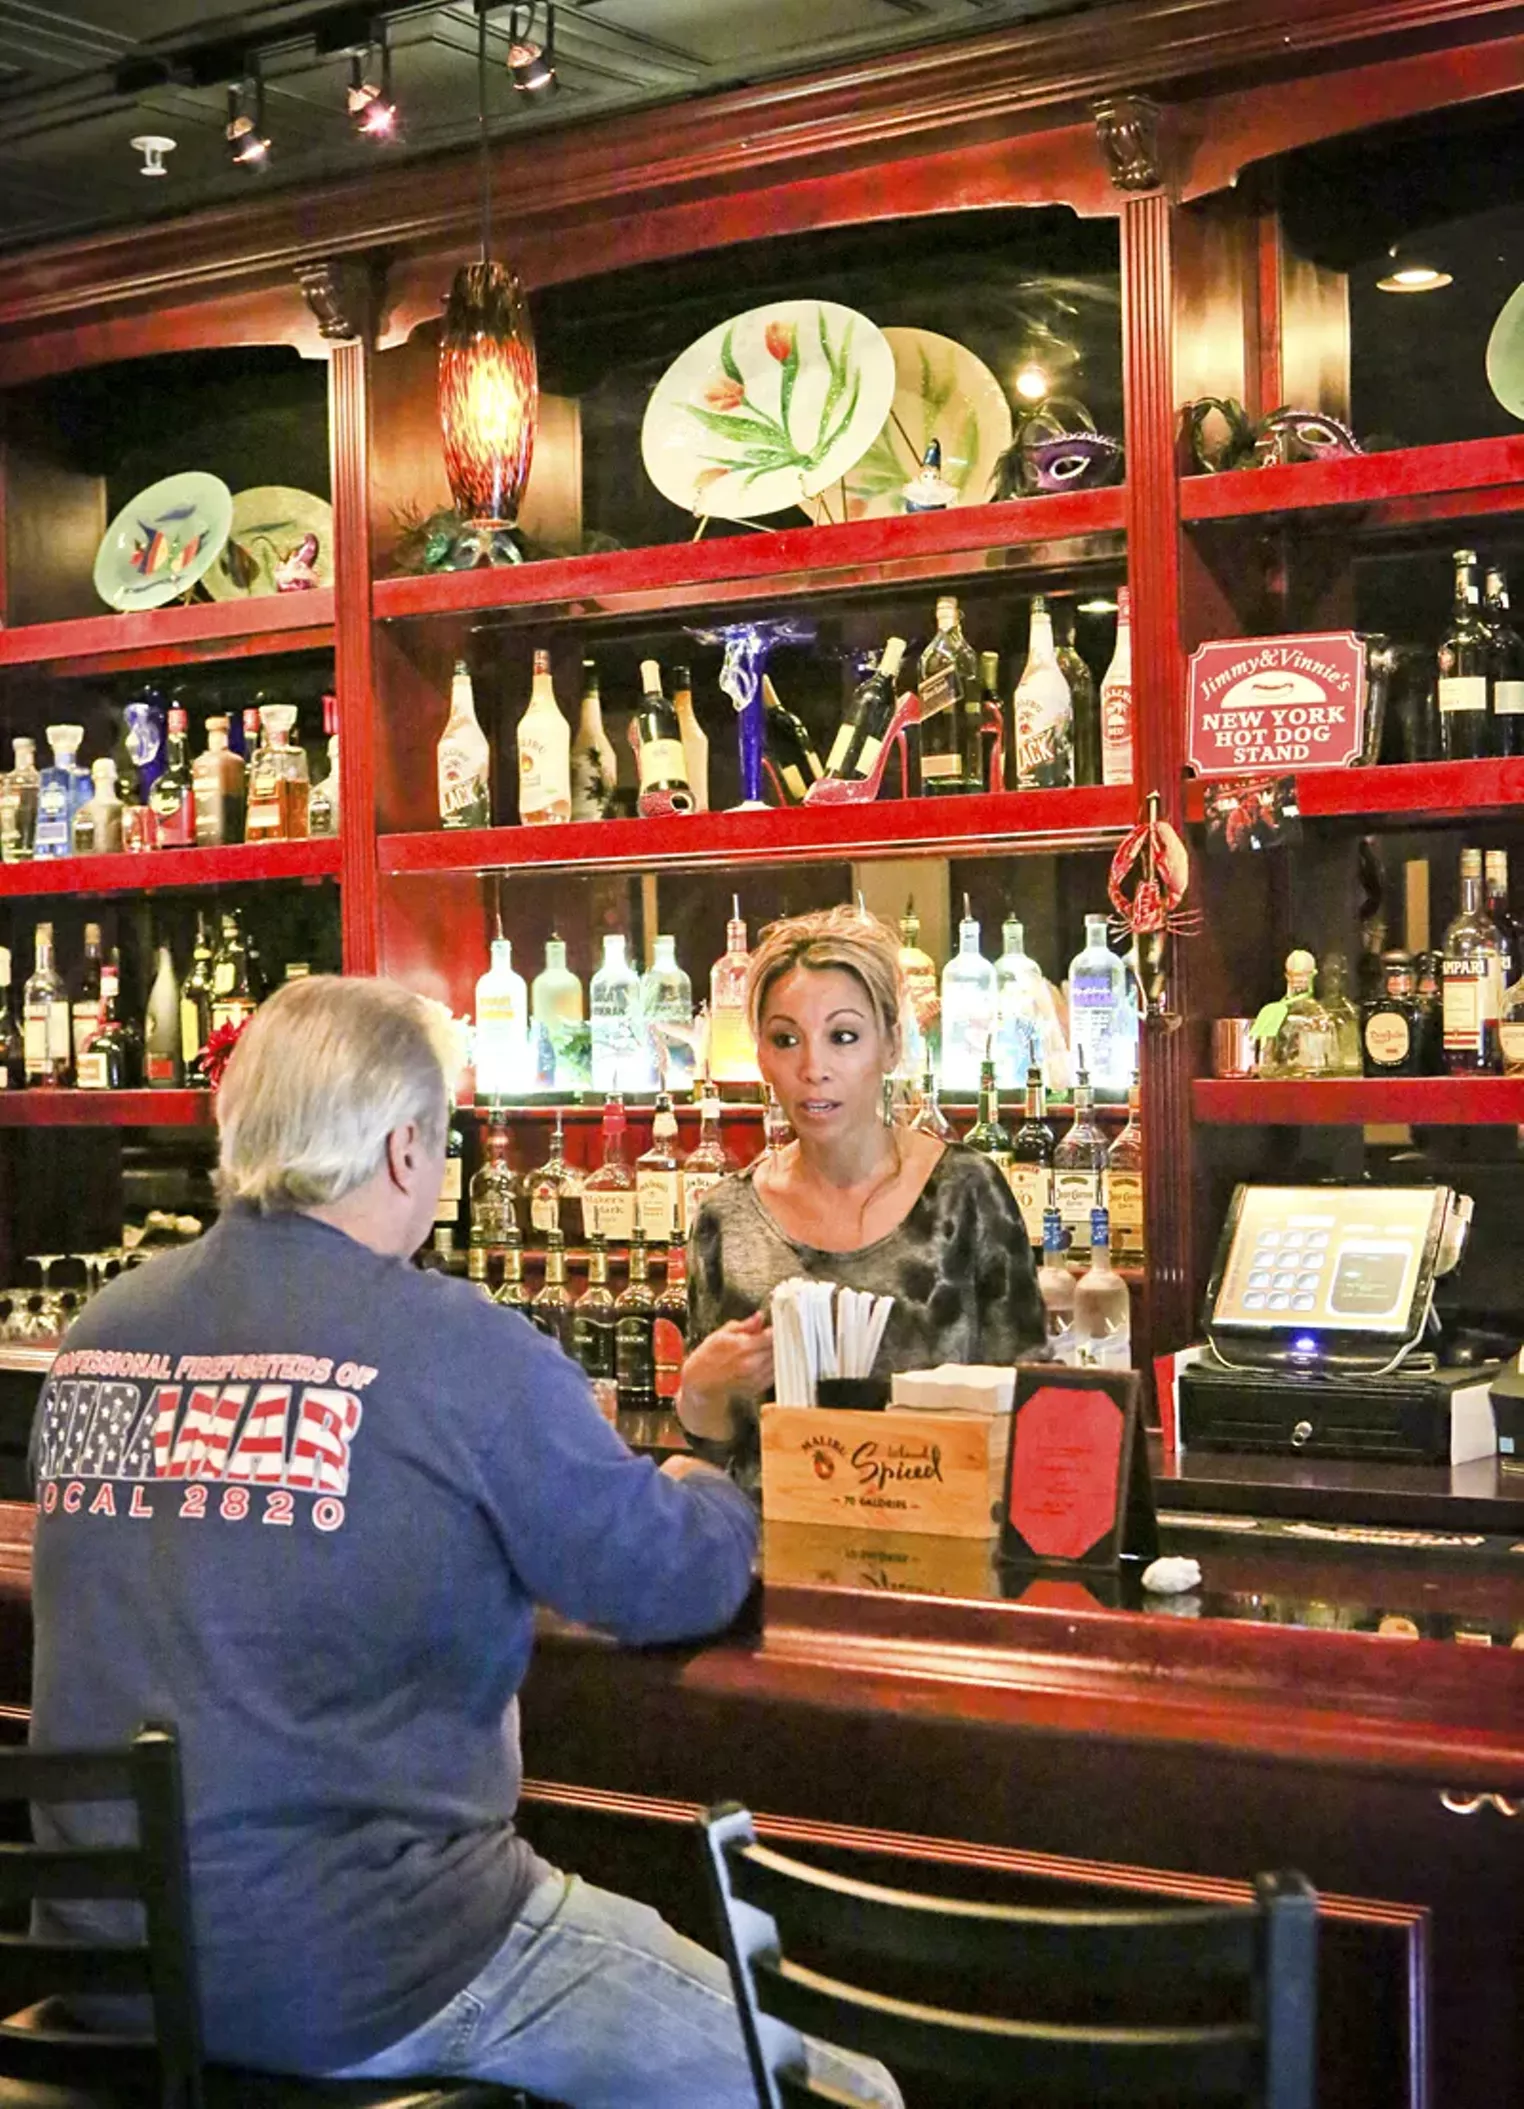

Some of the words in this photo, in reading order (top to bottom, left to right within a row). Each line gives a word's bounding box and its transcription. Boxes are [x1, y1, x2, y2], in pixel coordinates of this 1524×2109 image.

[1202, 711, 1264, 731] NEW
[1271, 706, 1346, 726] YORK
[1214, 729, 1268, 747] HOT
[1274, 725, 1331, 743] DOG
[1233, 744, 1310, 763] STAND
[335, 1361, 379, 1390] OF
[851, 1440, 943, 1490] Spiced
[38, 1481, 153, 1518] OCAL
[179, 1483, 345, 1531] 2820
